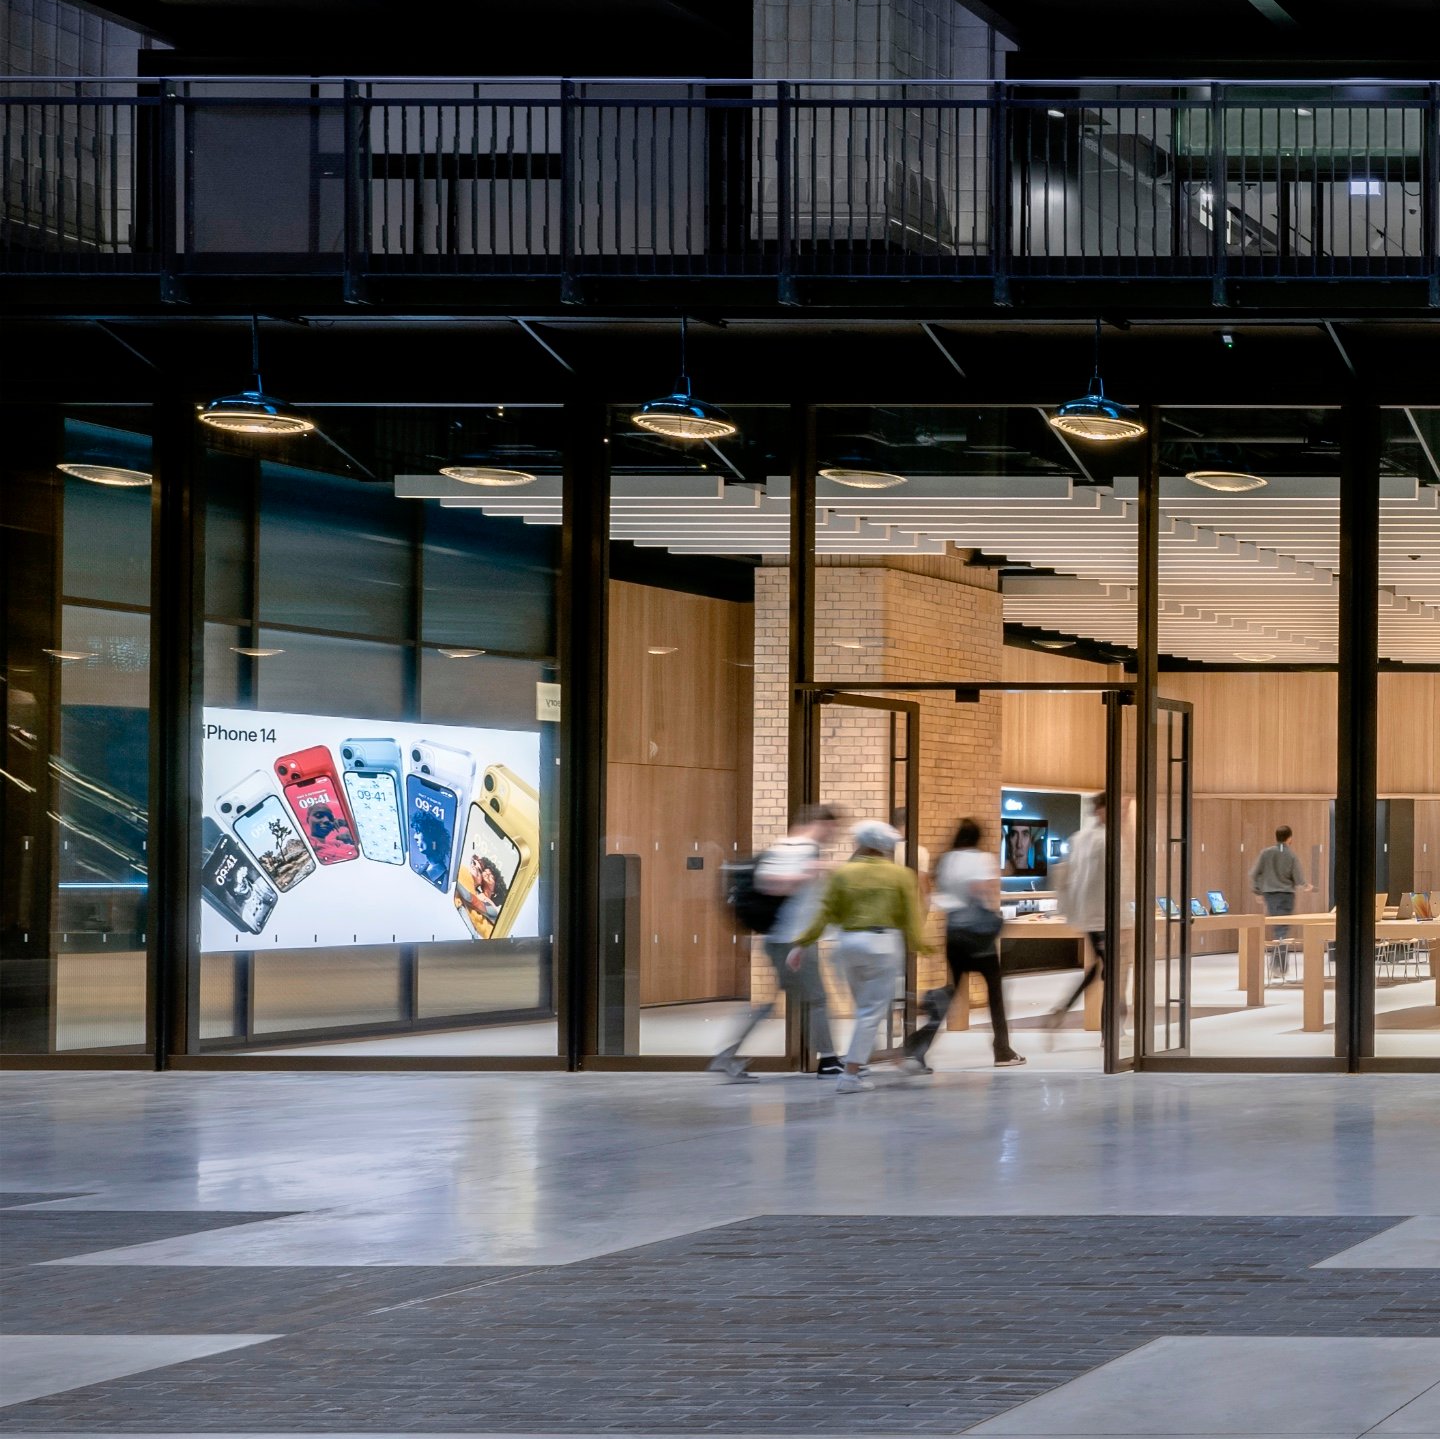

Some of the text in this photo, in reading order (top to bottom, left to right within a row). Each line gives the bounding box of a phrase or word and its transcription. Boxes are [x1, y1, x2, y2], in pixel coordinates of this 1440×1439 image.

[260, 728, 277, 743] 14
[299, 792, 330, 809] 09:41
[415, 797, 445, 820] 09:41
[215, 854, 238, 886] 09:41
